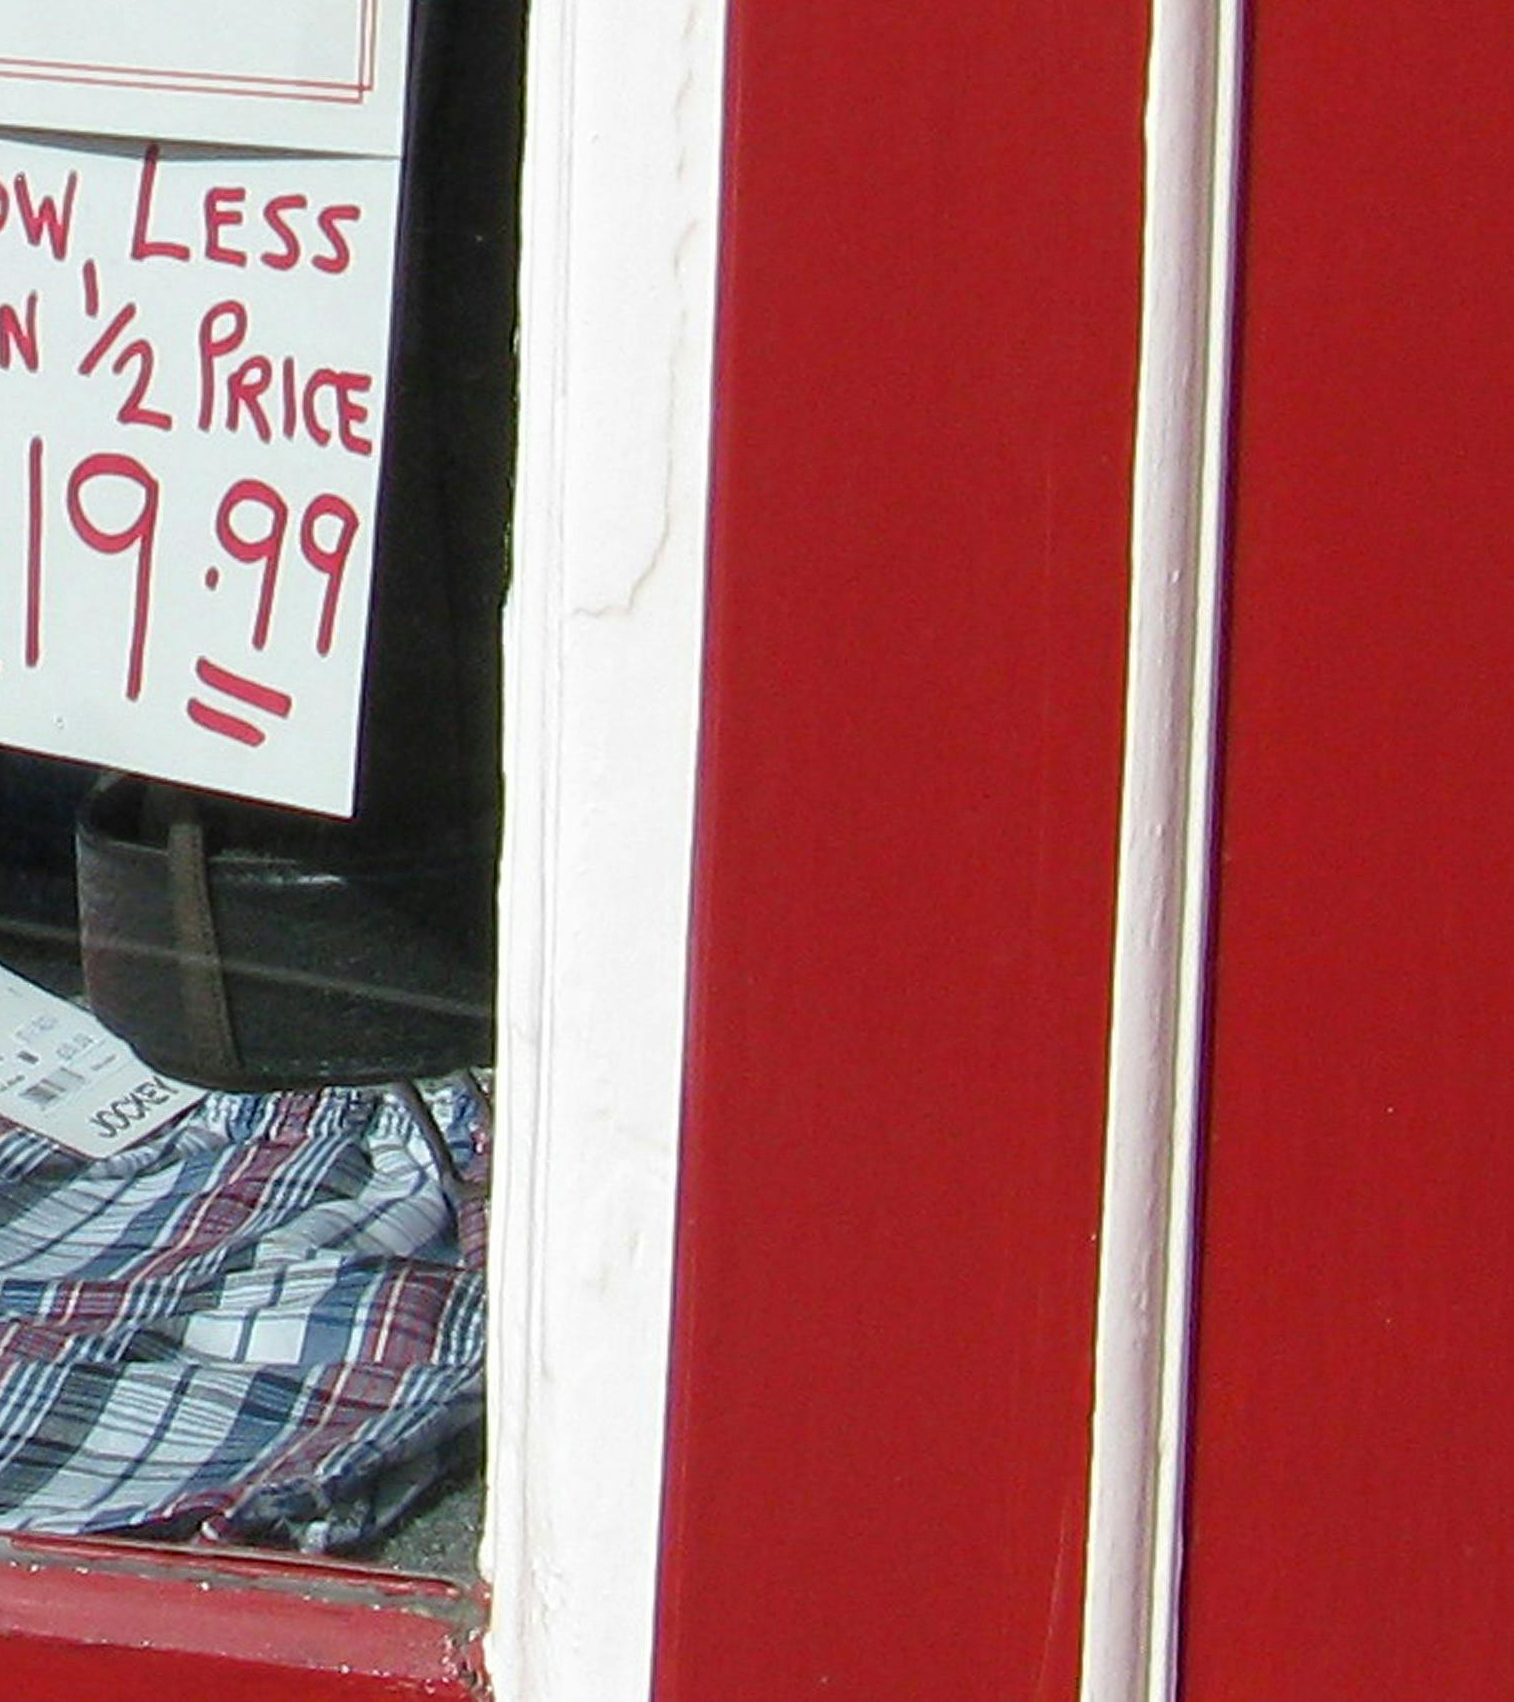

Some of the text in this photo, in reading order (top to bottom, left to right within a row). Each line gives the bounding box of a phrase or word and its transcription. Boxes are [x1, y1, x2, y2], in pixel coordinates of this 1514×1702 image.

[129, 142, 362, 275] LESS
[197, 298, 375, 456] PRICE
[89, 1075, 180, 1139] JOCKEY
